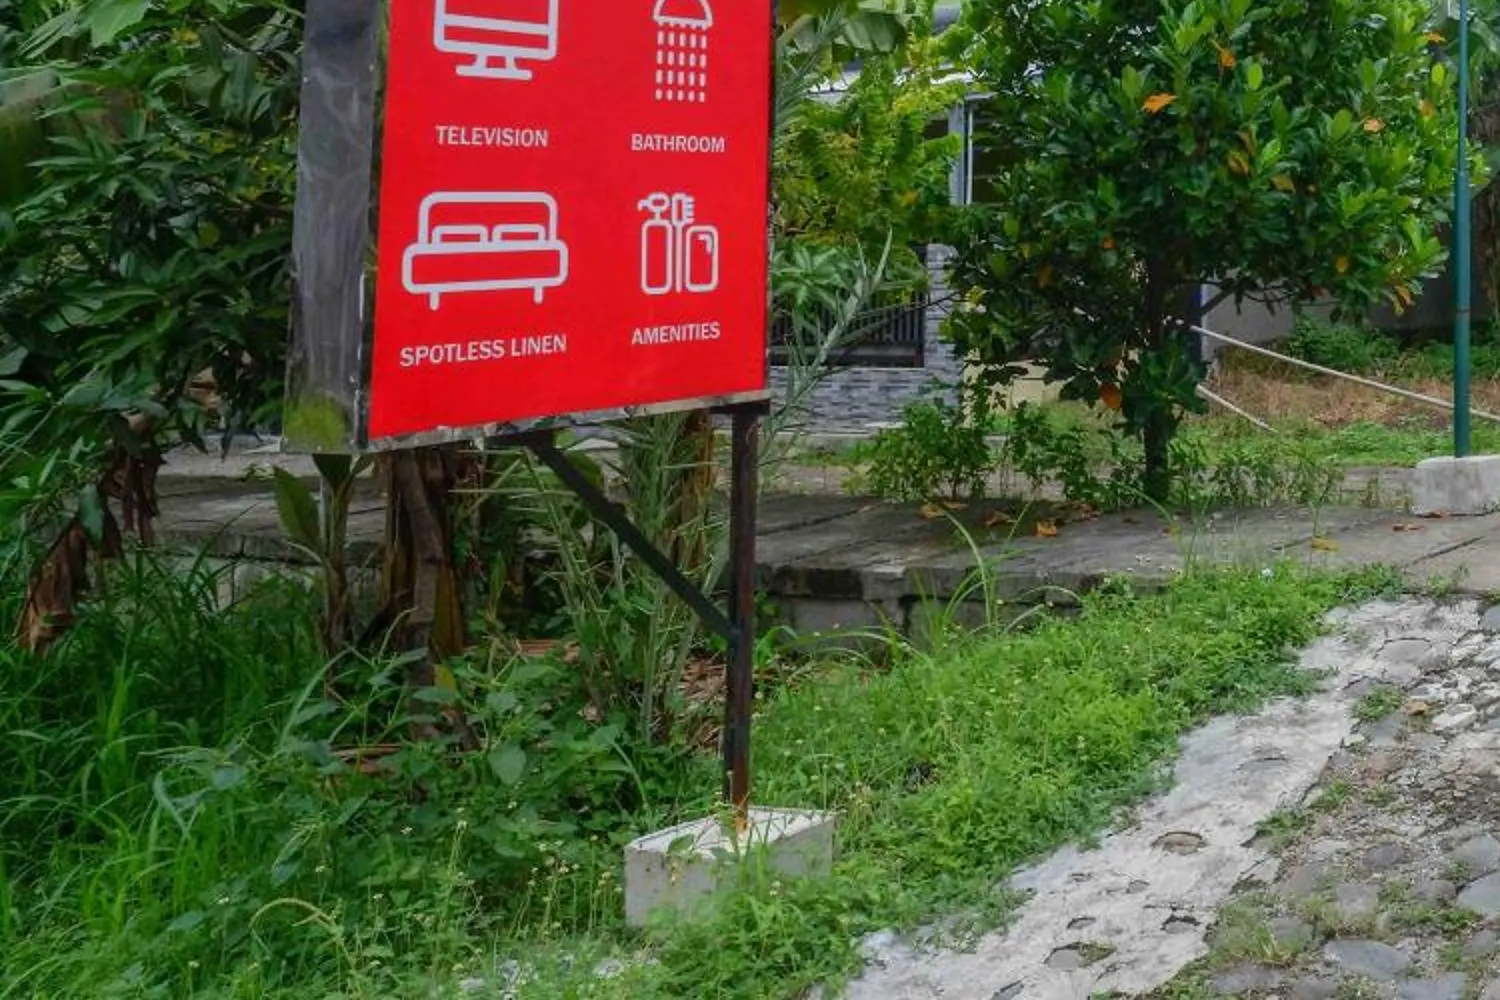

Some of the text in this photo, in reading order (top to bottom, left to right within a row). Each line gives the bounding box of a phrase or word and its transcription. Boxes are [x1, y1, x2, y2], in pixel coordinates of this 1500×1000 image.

[435, 124, 549, 148] TELEVISION
[631, 132, 726, 154] BATHROOM
[631, 320, 721, 346] AMENITIES
[400, 333, 567, 368] SPOTLESS LINEN
